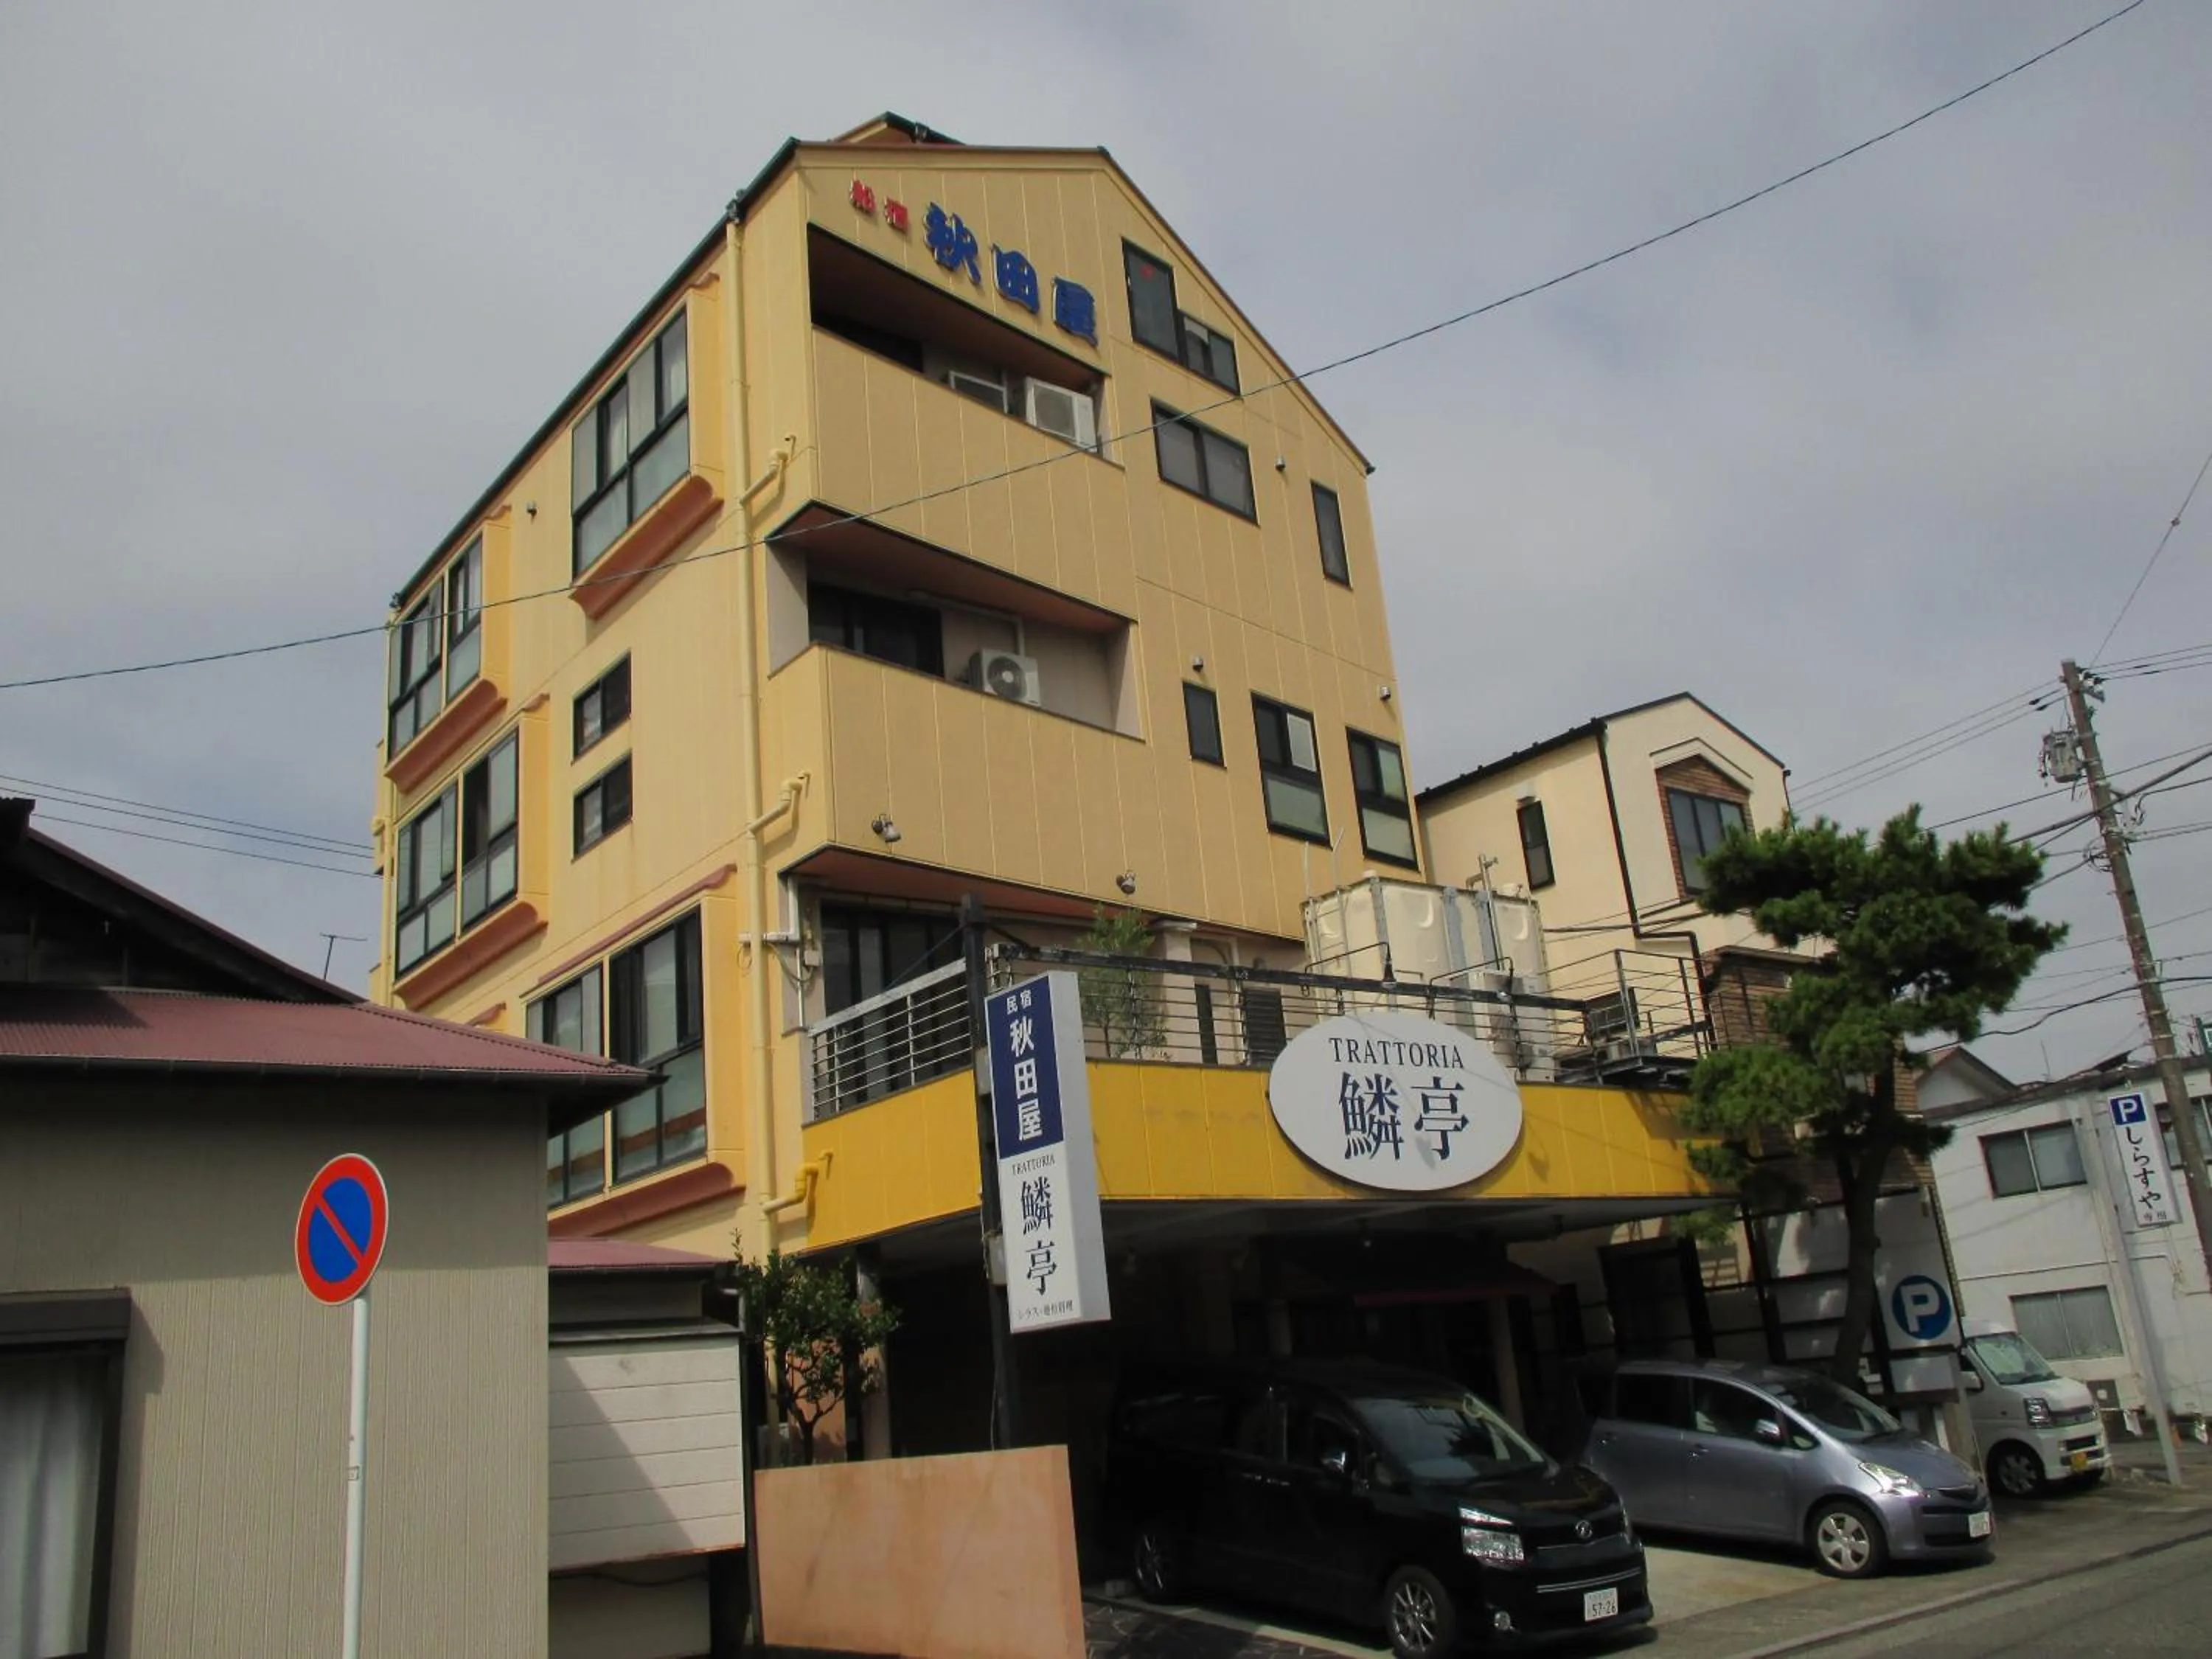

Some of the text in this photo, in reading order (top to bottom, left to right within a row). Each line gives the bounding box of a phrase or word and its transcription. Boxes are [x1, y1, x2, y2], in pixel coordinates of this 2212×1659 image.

[923, 201, 1099, 347] 秋田屋
[1009, 1016, 1043, 1141] 秋田屋
[1329, 1037, 1465, 1069] TRATTORIA
[1339, 1071, 1470, 1161] 鱗亭
[2118, 1098, 2138, 1123] P
[1012, 1153, 1056, 1176] TRATTORIA
[2126, 1127, 2161, 1209] しらすや
[1020, 1176, 1057, 1296] 鱗亭
[1899, 1283, 1940, 1333] P
[1592, 1599, 1617, 1617] 57-26
